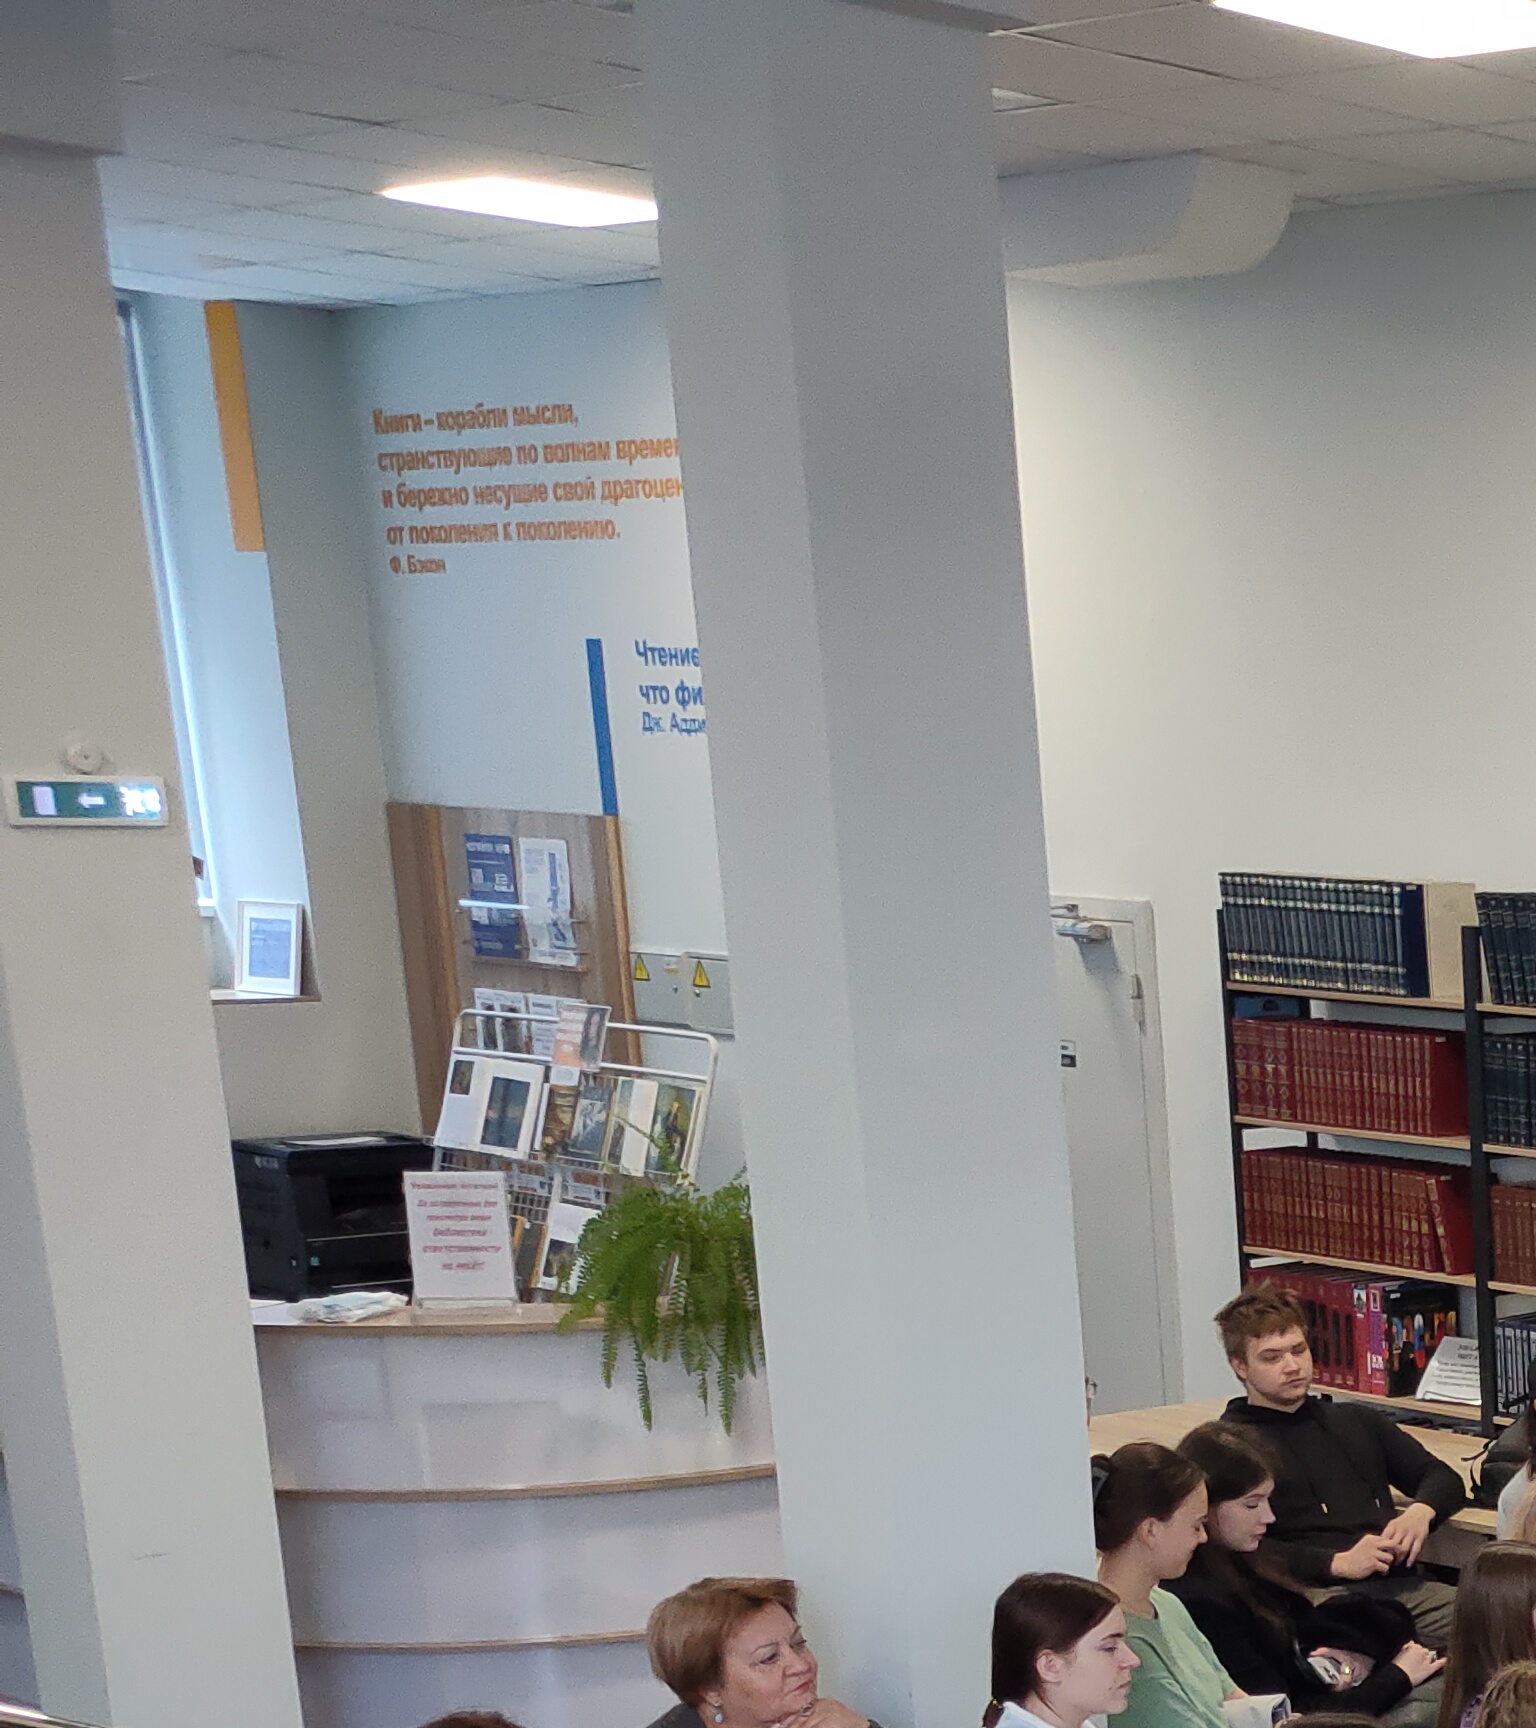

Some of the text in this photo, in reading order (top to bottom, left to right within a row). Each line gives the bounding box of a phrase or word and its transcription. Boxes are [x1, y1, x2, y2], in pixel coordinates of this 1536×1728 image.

[373, 408, 422, 435] Книги
[436, 402, 508, 436] корабли
[512, 404, 578, 427] мысли,
[378, 446, 512, 476] странствующие
[516, 444, 538, 464] по
[543, 441, 610, 463] волнам
[382, 489, 393, 509] и
[396, 482, 469, 512] бережно
[473, 483, 547, 511] несущие
[552, 476, 596, 502] свой
[387, 526, 404, 545] от
[409, 523, 498, 544] поколения
[503, 522, 512, 541] к
[407, 554, 446, 574] Бэкон
[635, 639, 700, 667] Чтение
[639, 685, 670, 704] что
